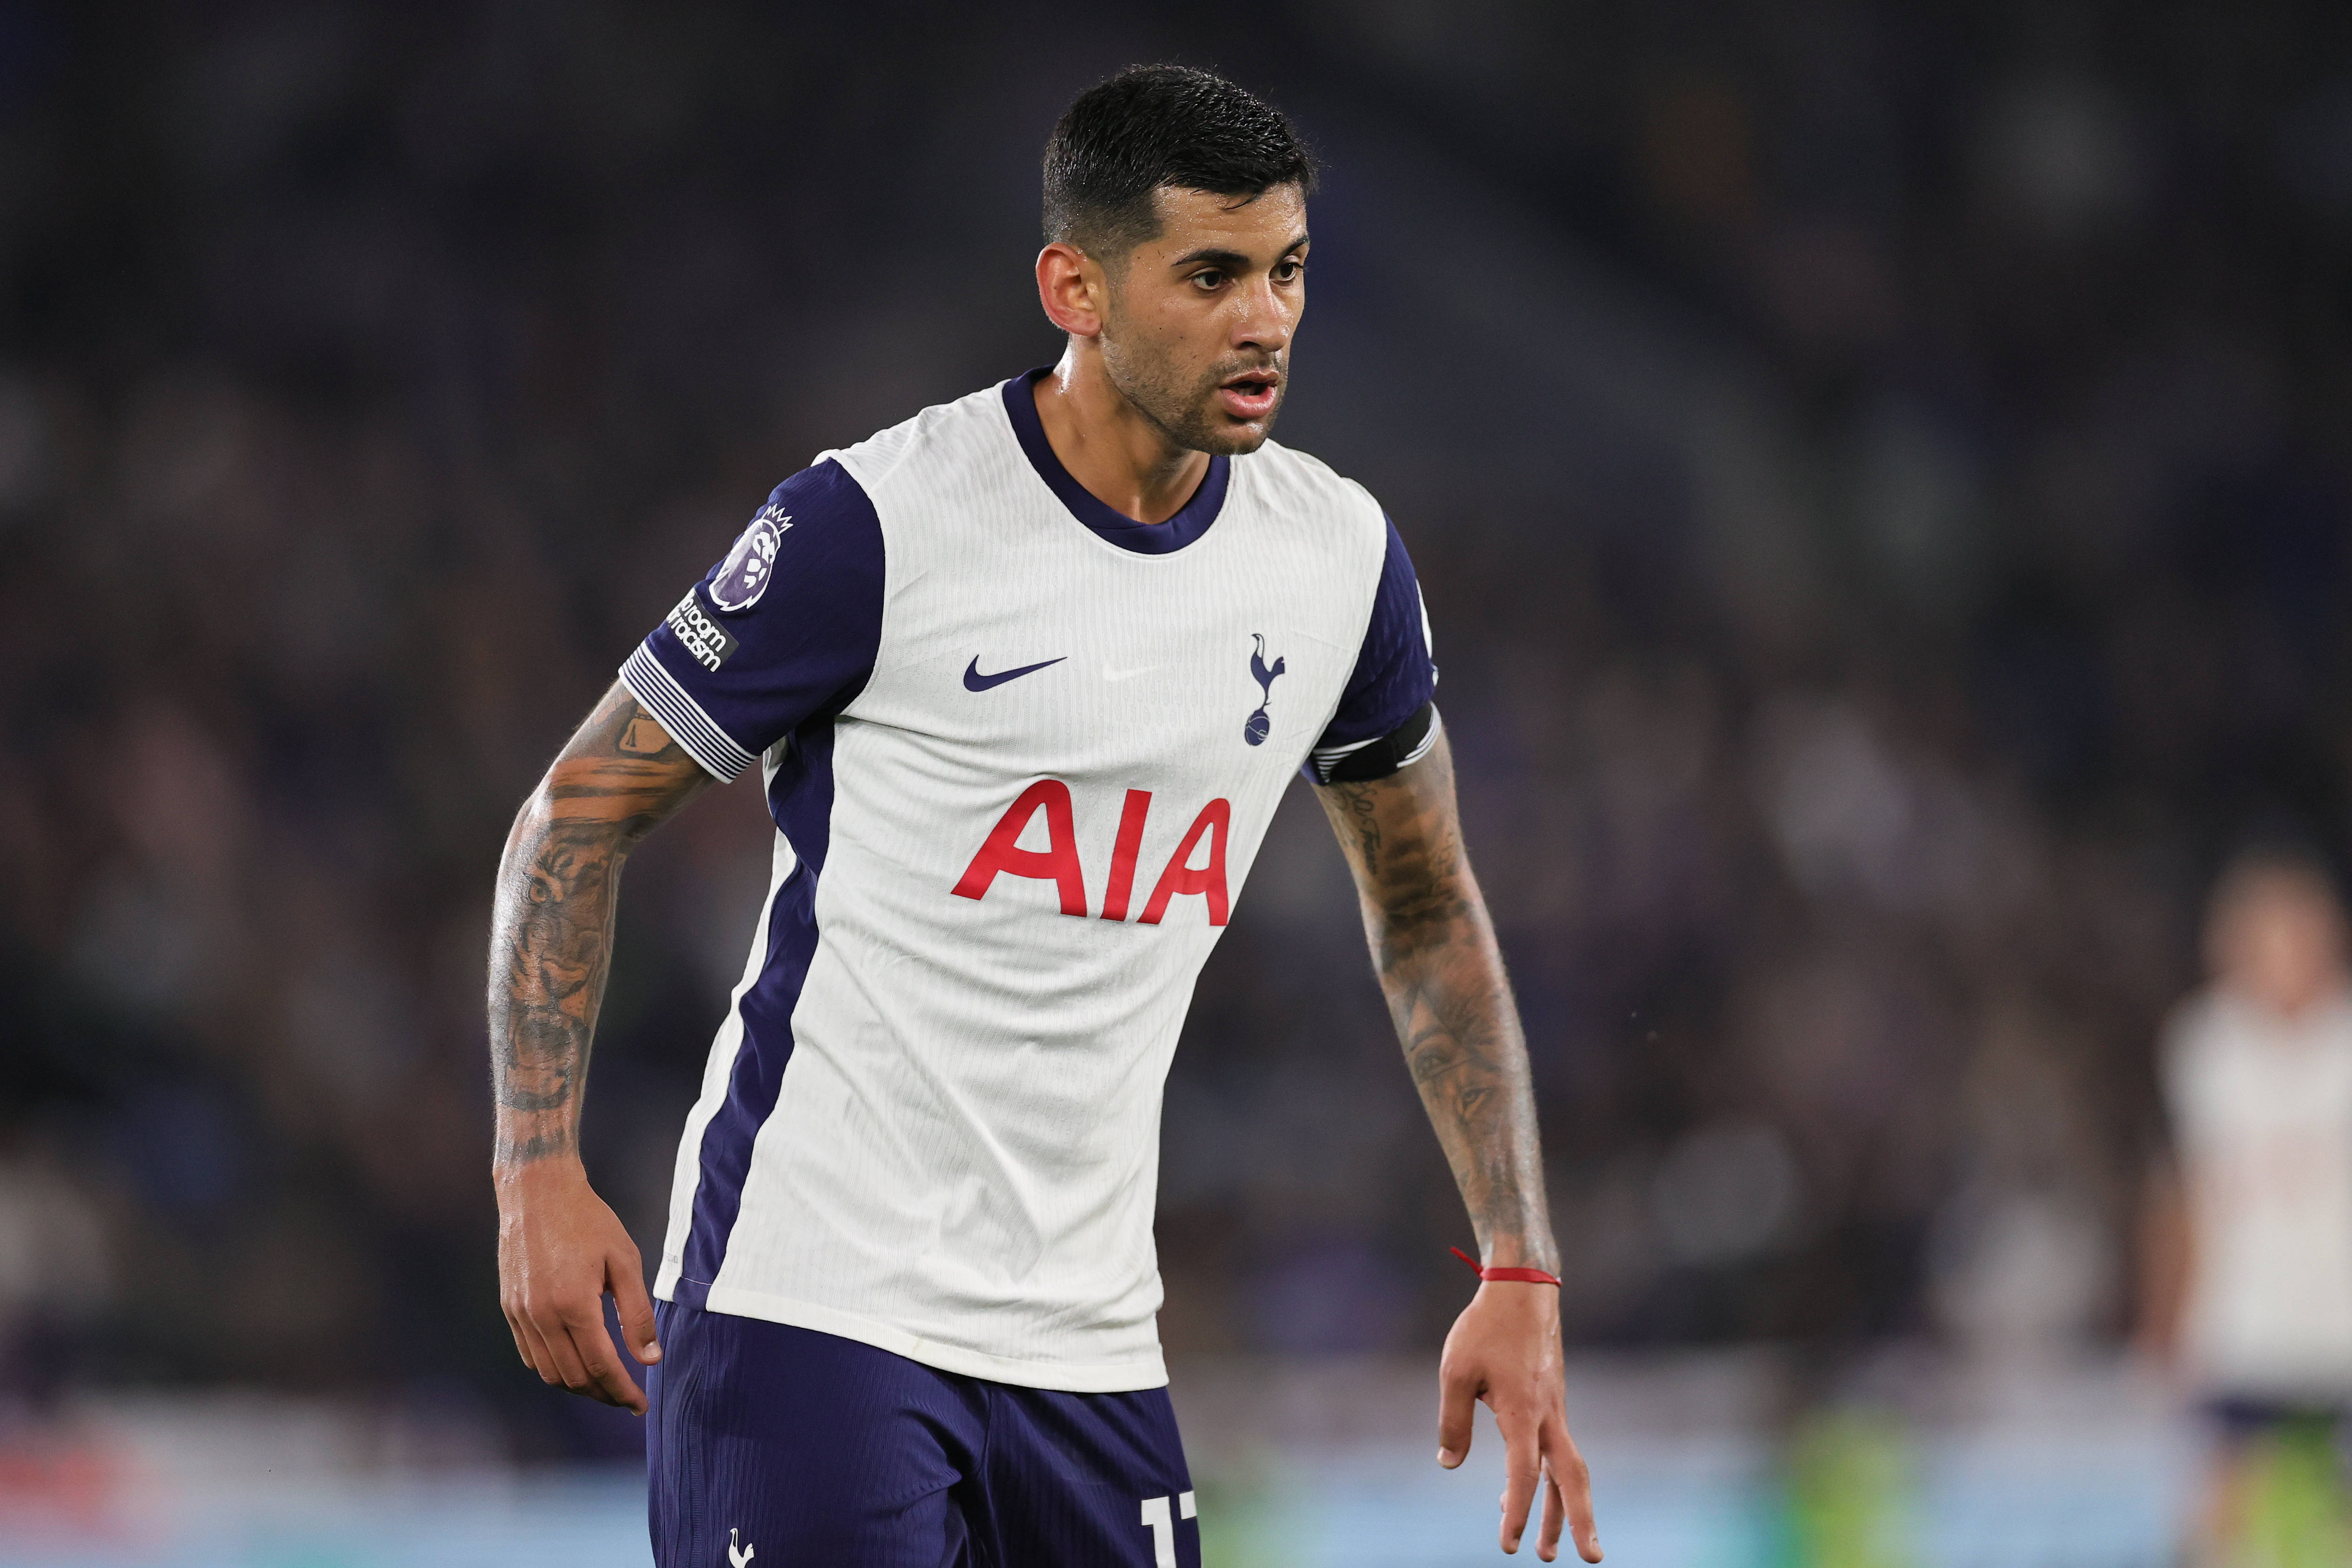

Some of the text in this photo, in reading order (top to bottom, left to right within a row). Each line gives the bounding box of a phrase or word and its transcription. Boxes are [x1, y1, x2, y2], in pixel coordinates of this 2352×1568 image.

[671, 617, 721, 672] racism
[684, 605, 726, 652] room
[951, 779, 1230, 926] AIA
